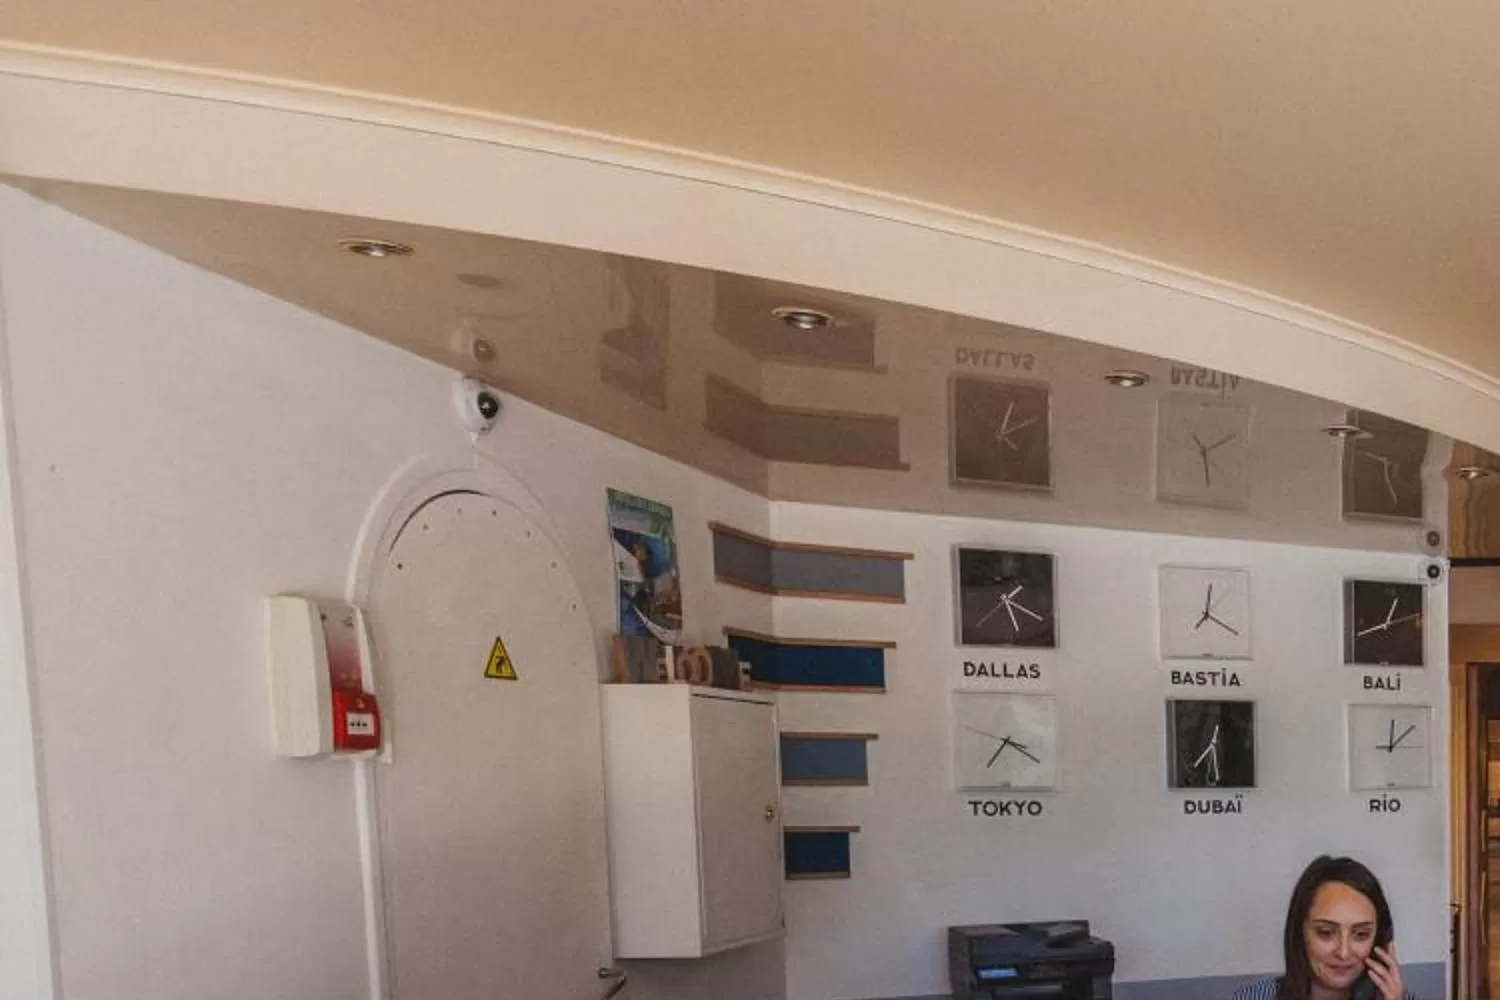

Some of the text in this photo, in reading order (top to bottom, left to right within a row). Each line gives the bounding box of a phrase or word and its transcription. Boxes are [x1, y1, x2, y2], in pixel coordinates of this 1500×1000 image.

[963, 661, 1041, 679] DALLAS
[967, 800, 1043, 817] TOKYO
[1184, 793, 1244, 814] DUBAÏ
